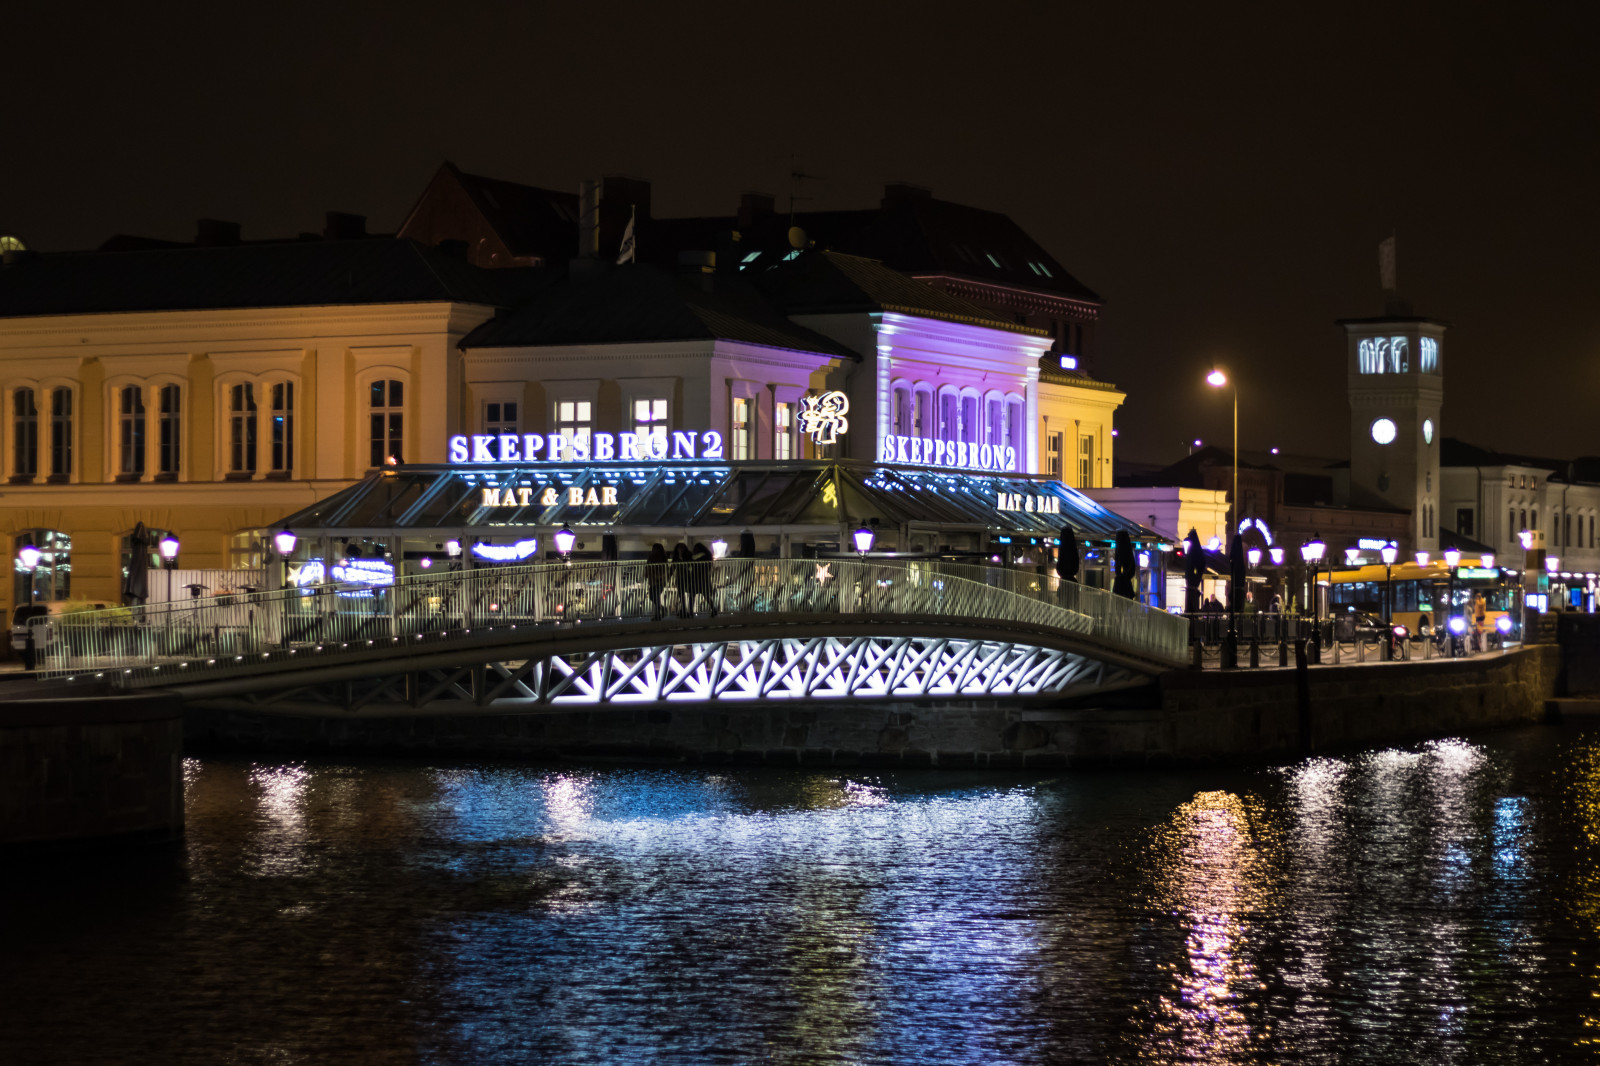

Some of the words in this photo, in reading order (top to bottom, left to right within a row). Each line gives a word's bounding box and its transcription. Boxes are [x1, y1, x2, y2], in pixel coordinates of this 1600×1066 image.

[482, 487, 533, 507] MAT
[541, 488, 559, 506] &
[569, 487, 618, 506] BAR
[997, 492, 1021, 511] MAT
[1025, 495, 1034, 513] &
[1036, 495, 1060, 514] BAR
